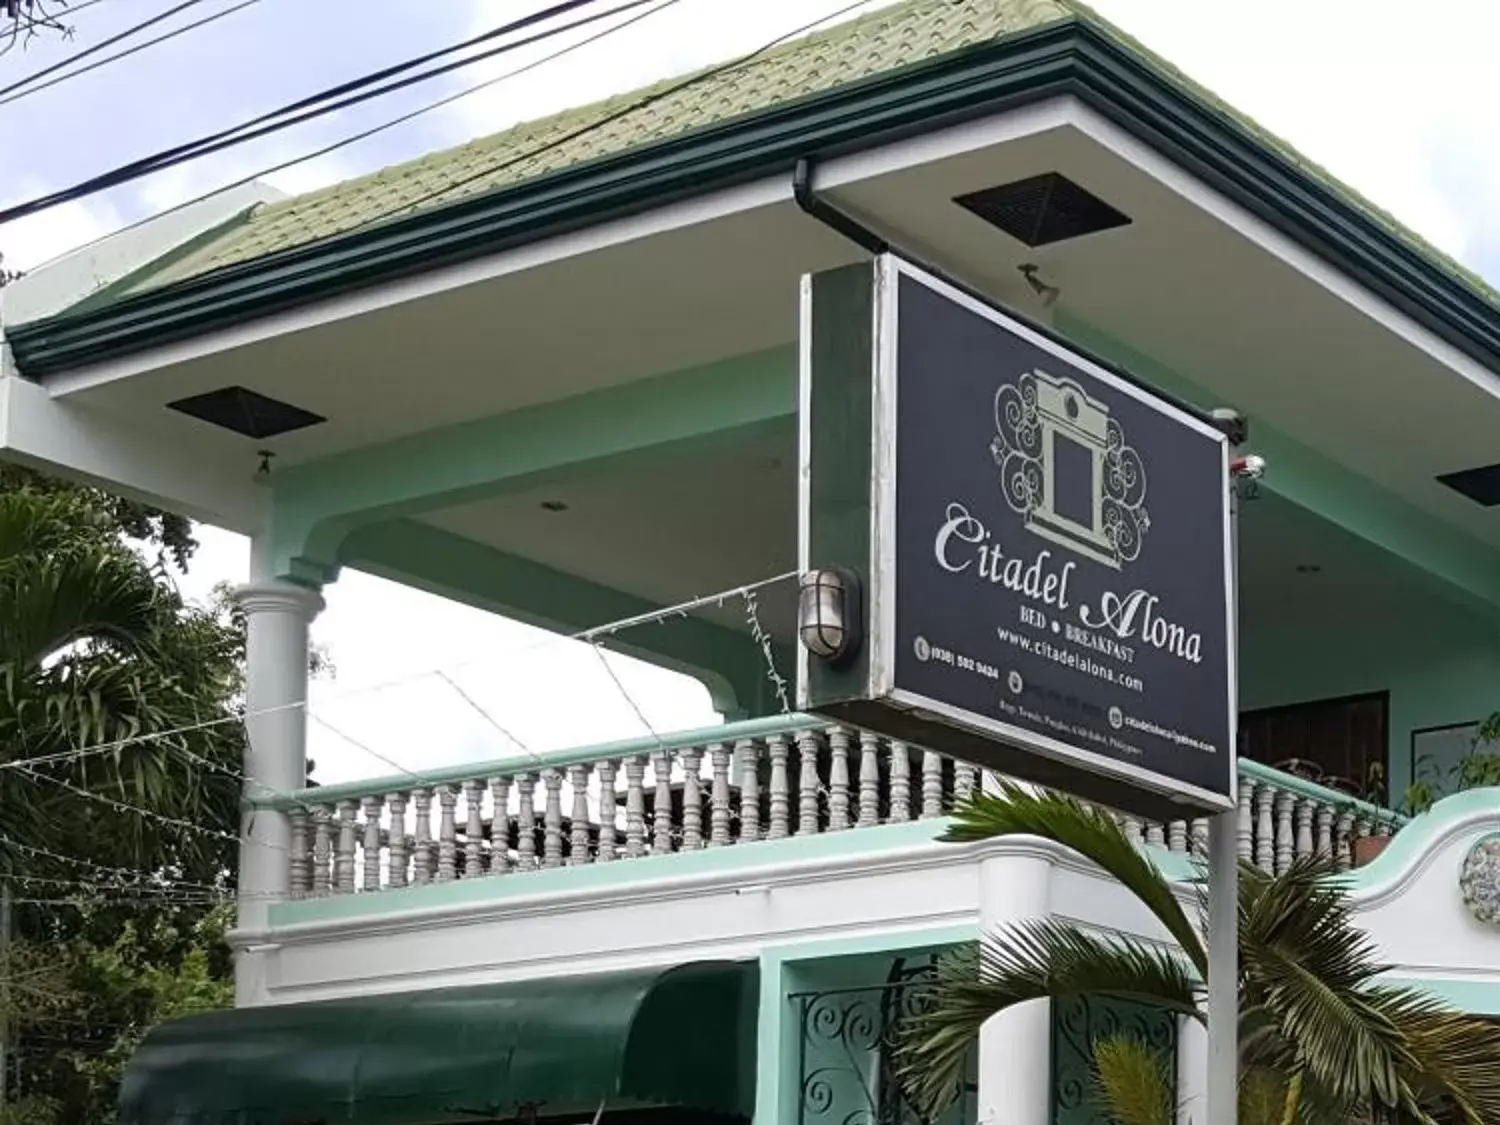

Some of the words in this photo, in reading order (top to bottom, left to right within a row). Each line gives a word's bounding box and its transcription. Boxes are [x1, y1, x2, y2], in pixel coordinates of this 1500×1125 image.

[935, 502, 1076, 609] Citadel
[1080, 589, 1203, 664] Alona
[997, 626, 1144, 692] www.citadelalona.com
[1019, 605, 1047, 629] BED
[1065, 623, 1136, 663] BREAKFAST
